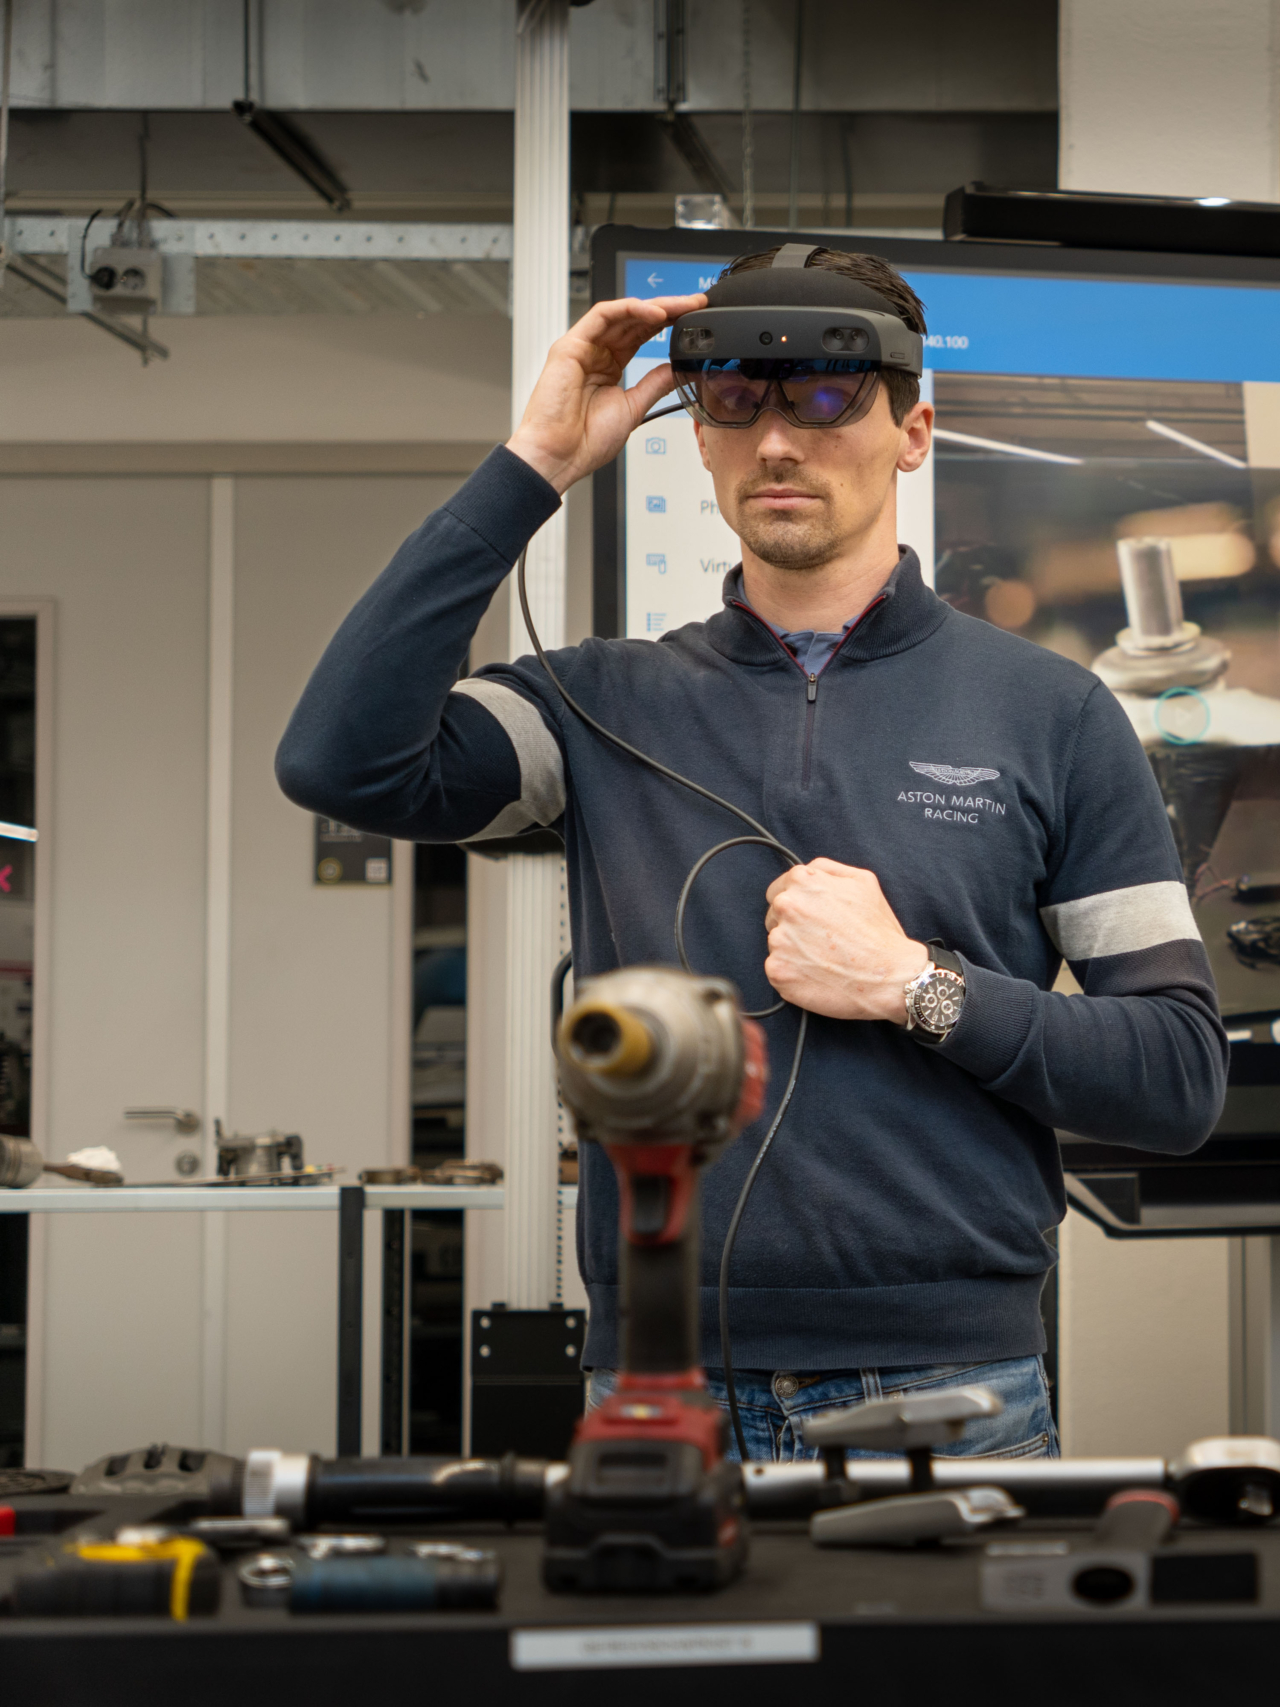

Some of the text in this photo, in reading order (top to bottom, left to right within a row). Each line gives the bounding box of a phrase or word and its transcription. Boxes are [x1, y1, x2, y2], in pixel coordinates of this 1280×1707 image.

[897, 791, 1006, 816] ASTON MARTIN
[924, 808, 979, 824] RACING
